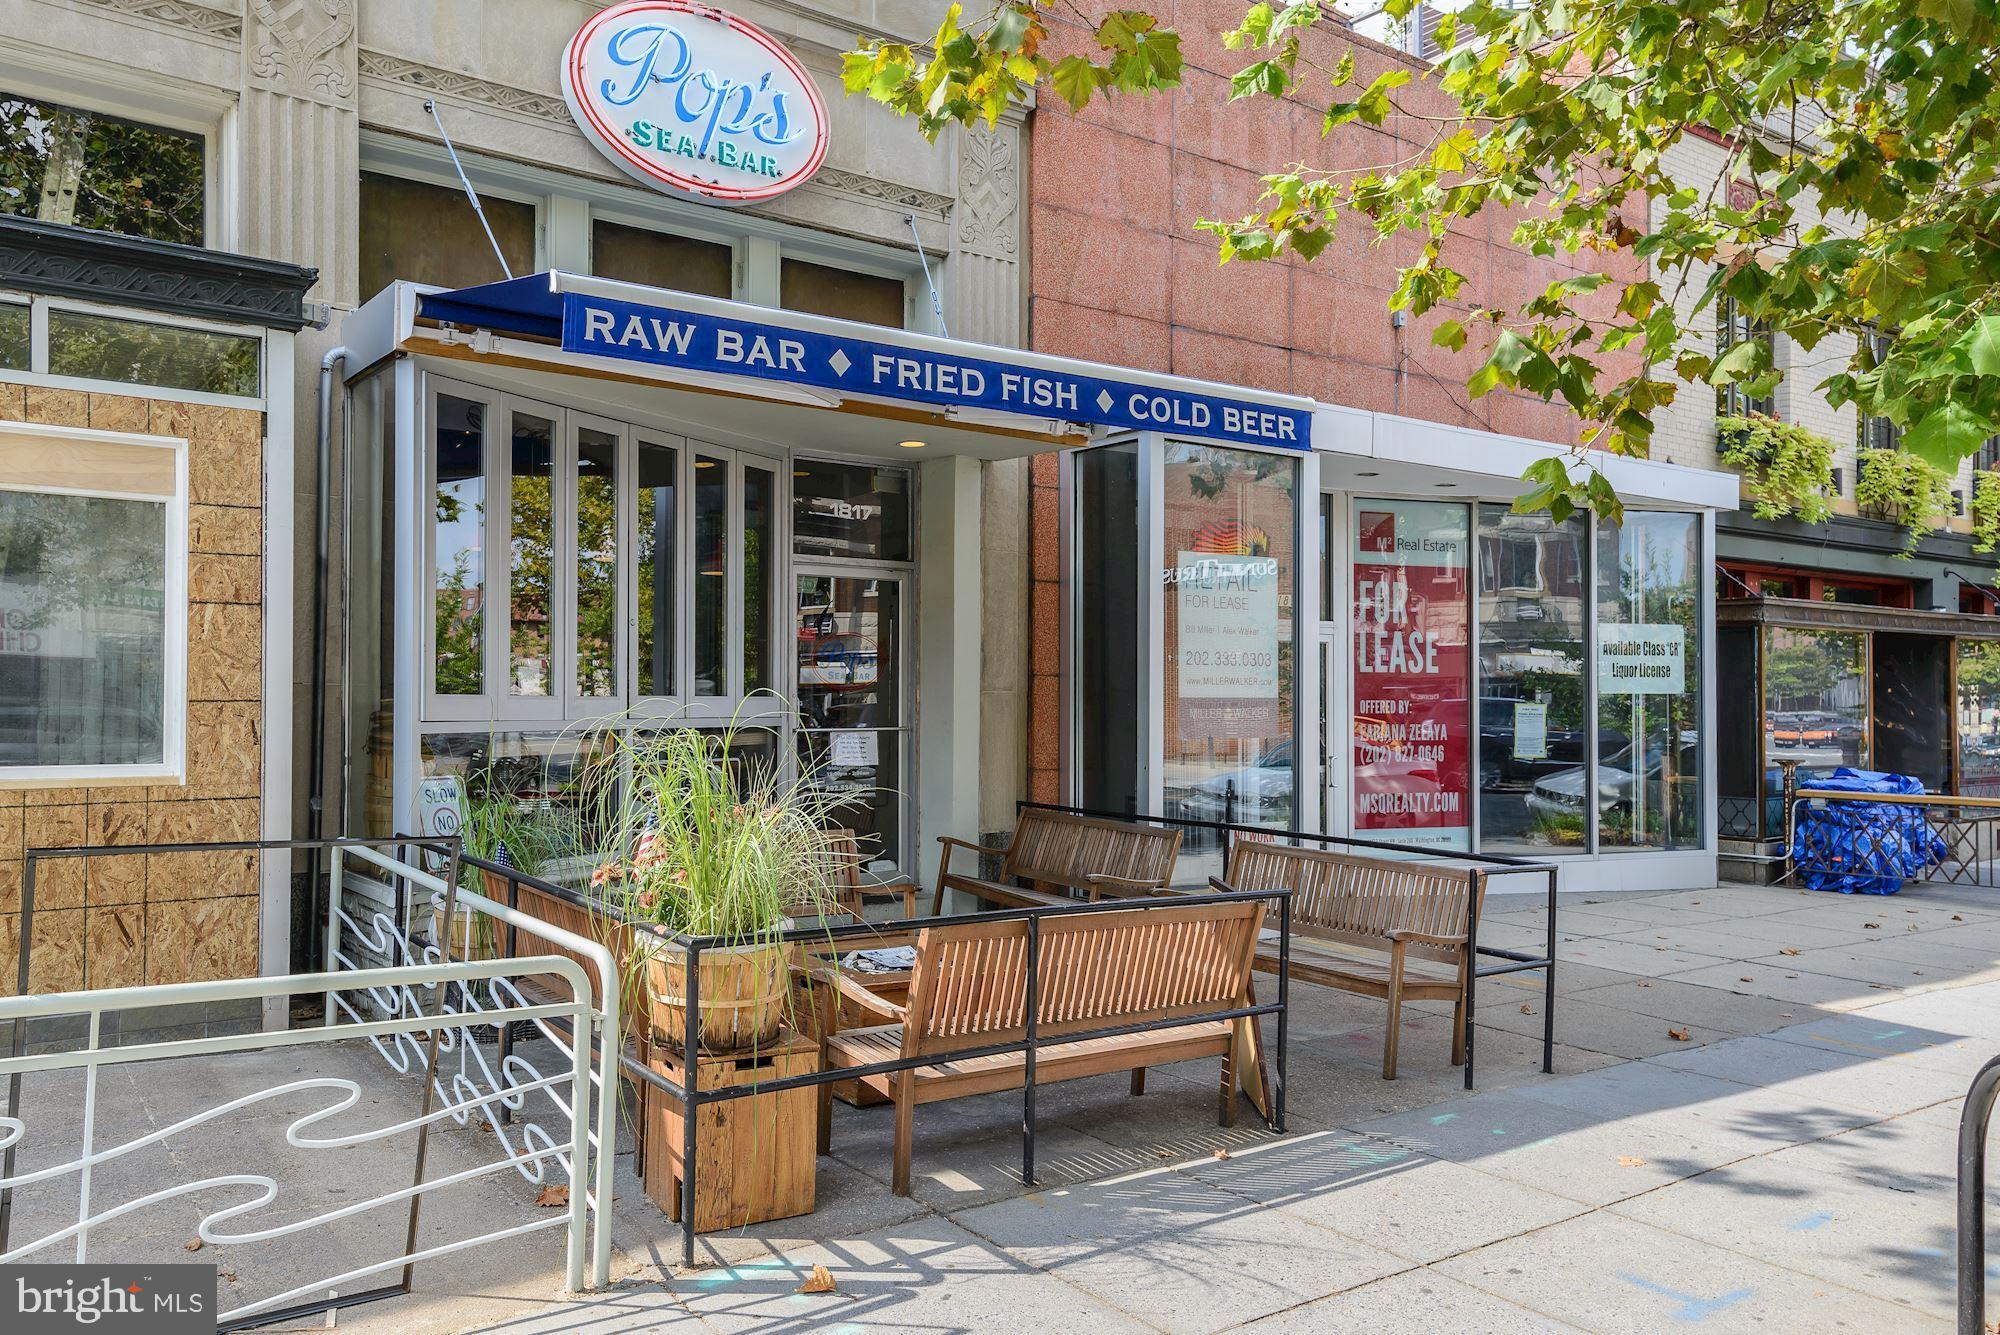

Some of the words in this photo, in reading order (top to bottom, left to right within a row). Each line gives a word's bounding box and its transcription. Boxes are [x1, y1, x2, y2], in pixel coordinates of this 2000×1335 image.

[601, 22, 808, 160] Pop's
[630, 119, 697, 159] SEA
[717, 140, 778, 178] BAR
[583, 307, 697, 355] RAW
[716, 328, 807, 373] BAR
[872, 353, 986, 397] FRIED
[1001, 373, 1078, 411] FISH
[1128, 393, 1211, 428] COLD
[1223, 406, 1298, 441] BEER
[829, 501, 873, 520] 1817
[1397, 538, 1420, 550] Real
[1424, 538, 1457, 552] Estate
[1185, 594, 1209, 609] FOR
[1213, 595, 1249, 611] LEASE
[1359, 581, 1408, 624] FOR
[1359, 630, 1440, 674] LEASE
[1603, 640, 1641, 657] Available
[1643, 640, 1666, 657] Class
[1612, 662, 1638, 679] Liquor
[1639, 662, 1671, 678] License
[1360, 699, 1397, 714] OFFERED
[1398, 699, 1413, 714] BY:
[425, 787, 457, 804] SLOW
[1360, 792, 1459, 814] MSQREALTY.COM
[437, 815, 454, 830] NO
